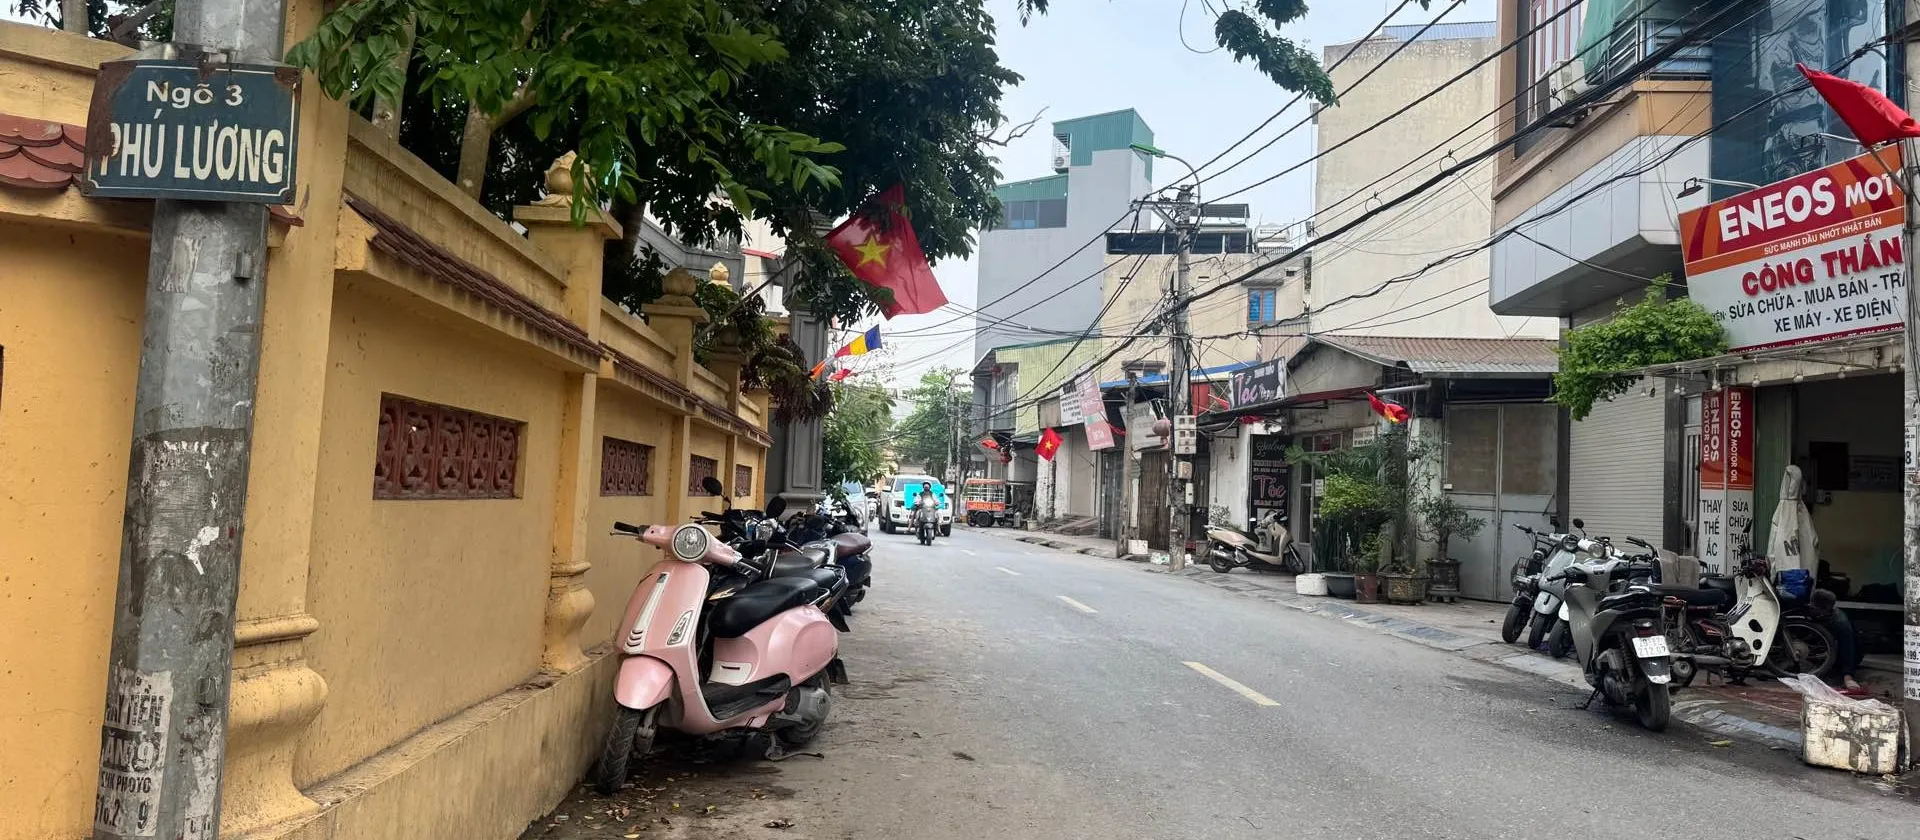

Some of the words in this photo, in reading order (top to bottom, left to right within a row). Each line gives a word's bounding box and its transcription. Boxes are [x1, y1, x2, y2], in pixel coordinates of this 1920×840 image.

[146, 80, 215, 109] Ngõ
[225, 84, 244, 107] 3
[100, 108, 166, 178] PHÚ
[174, 119, 285, 184] LƯƠNG
[1718, 177, 1836, 242] ENEOS
[1764, 244, 1780, 257] SỨC
[1780, 238, 1801, 253] MẠNH
[1801, 232, 1818, 246] DẦU
[1819, 226, 1841, 242] NHỚT
[1842, 222, 1864, 238] NHẬT
[1864, 216, 1882, 233] BẢN
[1742, 258, 1815, 297] CÔNG
[1729, 301, 1756, 322] SỬA
[1758, 292, 1795, 315] CHỮA
[1804, 285, 1835, 312] MUA
[1838, 275, 1869, 300] BÁN
[1775, 314, 1790, 334] XE
[1794, 308, 1821, 330] MÁY
[1834, 306, 1852, 324] XE
[1856, 296, 1892, 321] ĐIỆN
[1710, 395, 1719, 462] ENEOS
[1731, 391, 1742, 438] ENEOS
[1730, 439, 1738, 467] MOTOR
[1702, 499, 1722, 513] THAY
[1732, 498, 1749, 512] SỬA
[1704, 515, 1720, 535] THẾ
